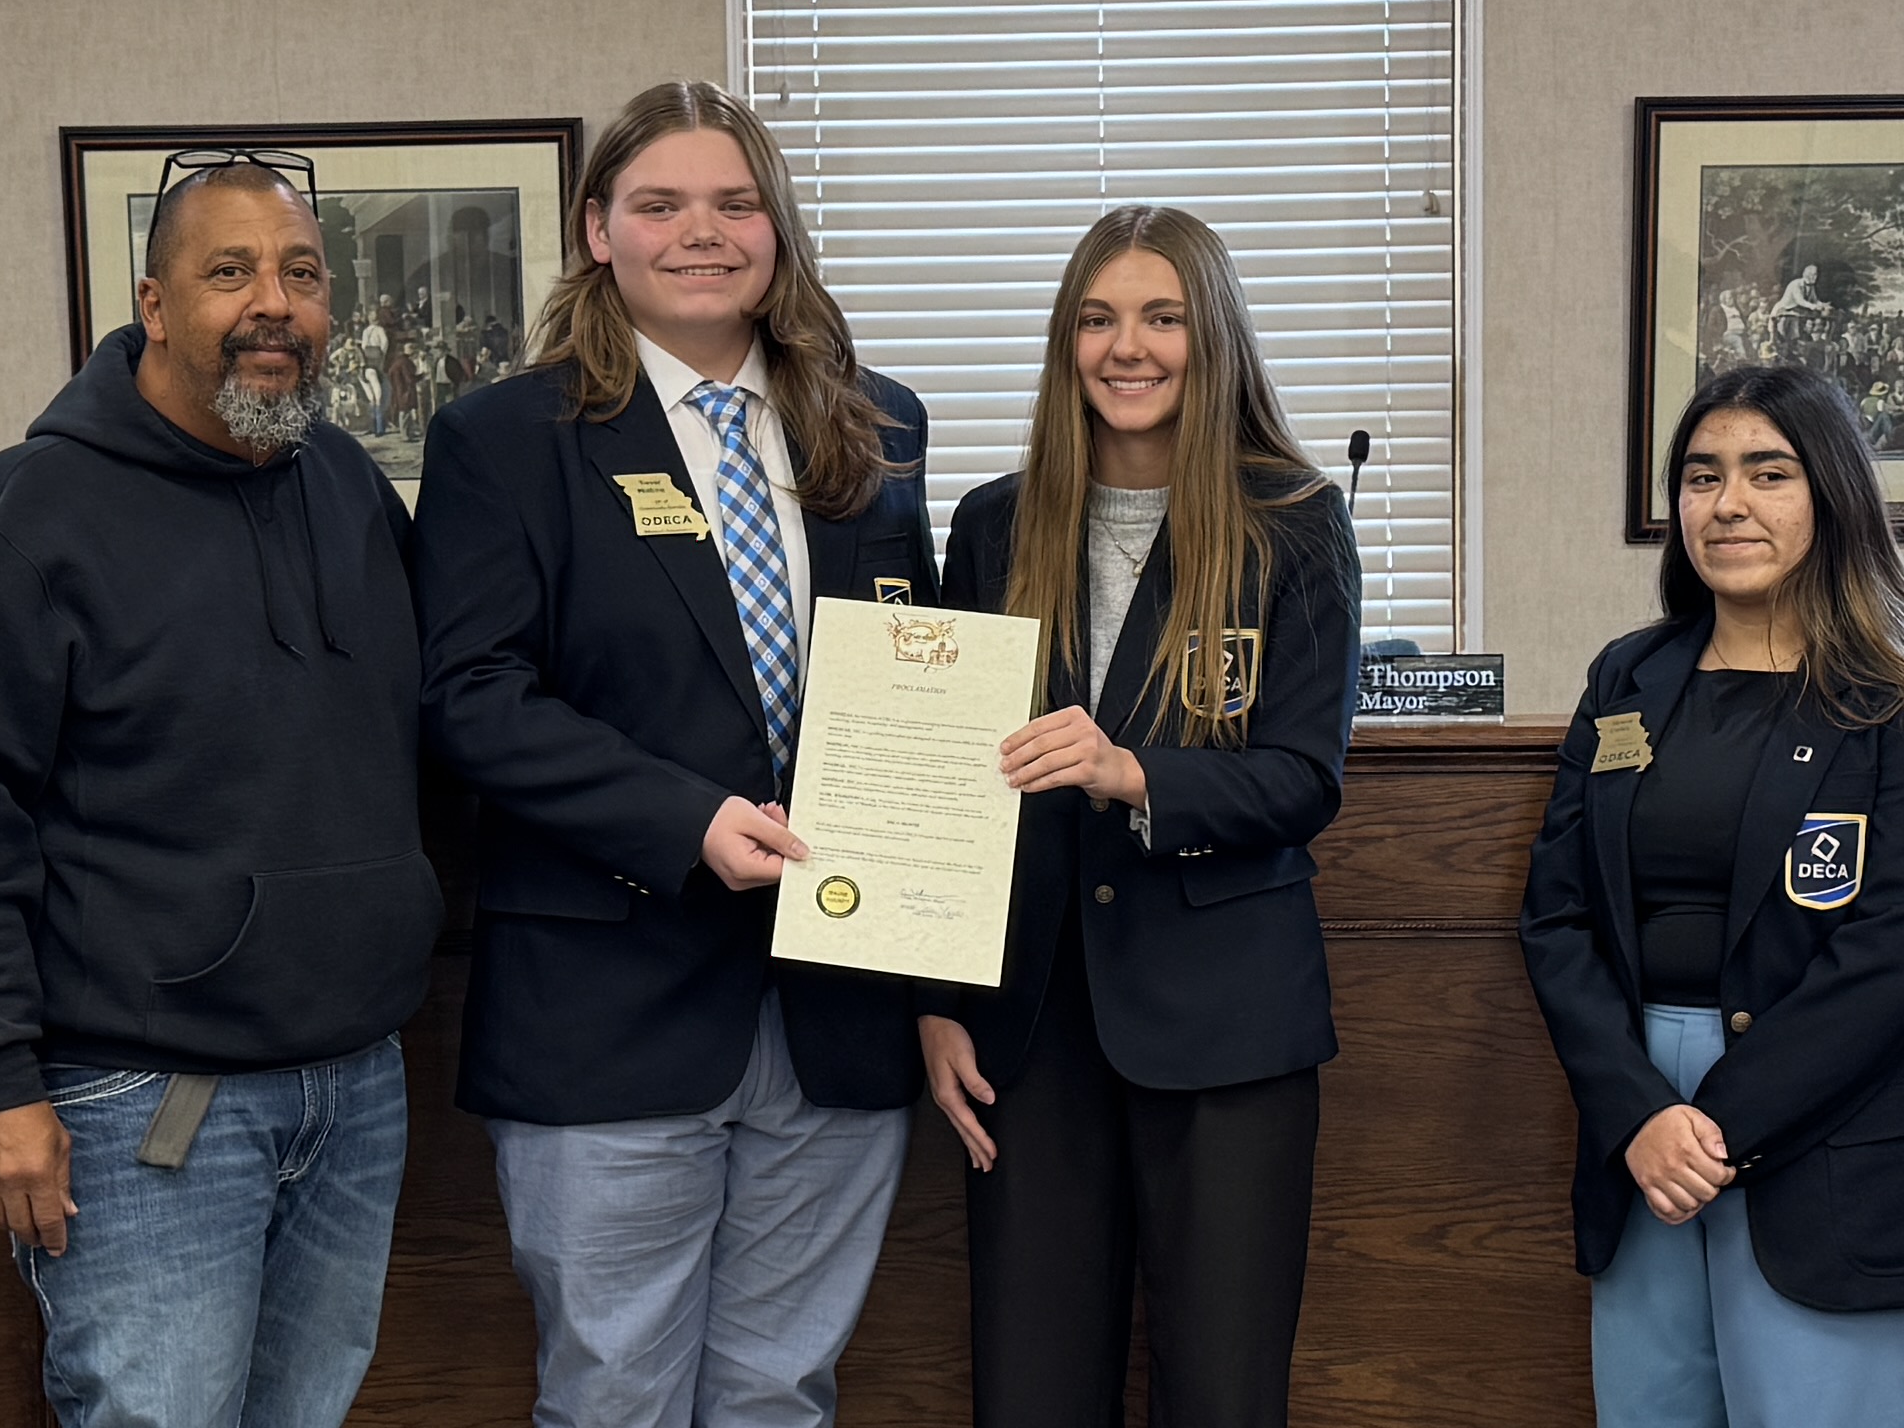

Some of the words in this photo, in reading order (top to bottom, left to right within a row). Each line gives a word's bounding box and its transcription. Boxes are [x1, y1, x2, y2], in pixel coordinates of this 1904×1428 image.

[1367, 664, 1496, 692] Thompson
[1360, 691, 1427, 714] Mayor
[1798, 863, 1849, 879] DECA
